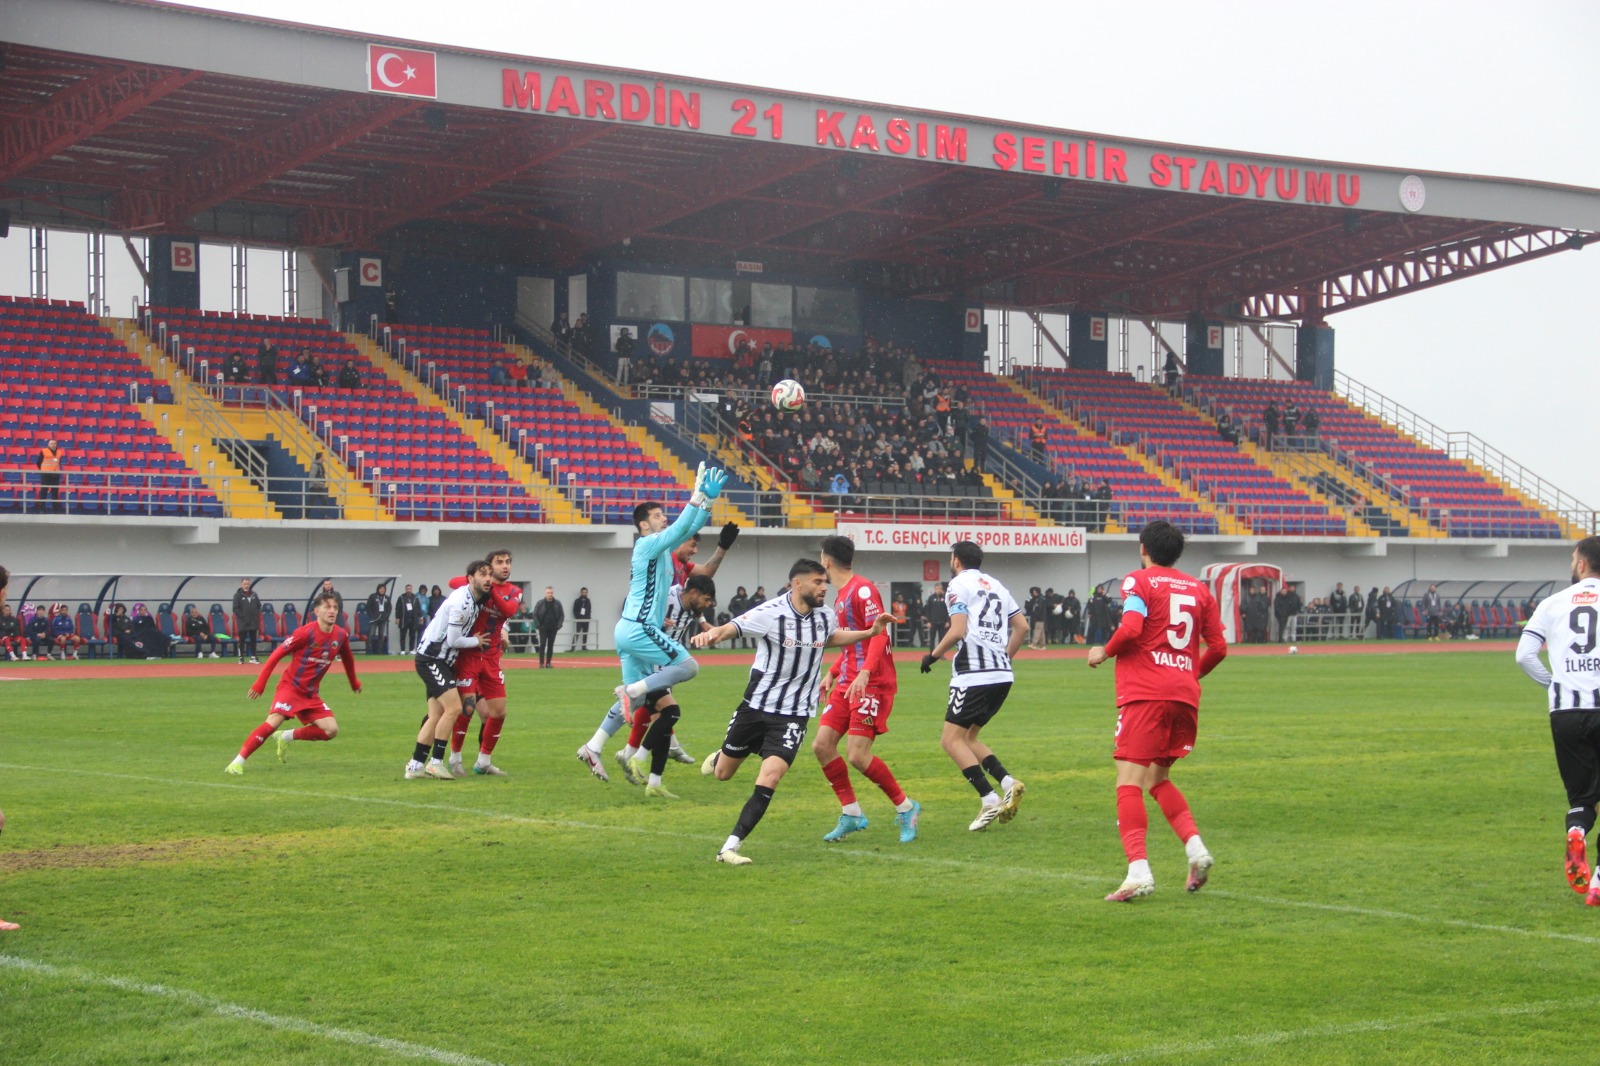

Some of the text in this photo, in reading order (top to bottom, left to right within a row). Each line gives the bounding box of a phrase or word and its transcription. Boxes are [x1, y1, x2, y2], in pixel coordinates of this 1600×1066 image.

[502, 68, 700, 129] MARDİN
[731, 98, 783, 139] 21
[816, 109, 967, 162] KASIM
[992, 132, 1128, 183] ŞEHİR
[1149, 153, 1361, 206] STADYUMU
[174, 247, 193, 267] B
[362, 262, 379, 282] C
[967, 311, 979, 328] D
[1091, 320, 1103, 337] E
[1209, 329, 1219, 345] F
[865, 530, 888, 544] T.C.
[892, 529, 950, 548] GENÇLİK
[976, 532, 1010, 546] SPOR
[1014, 530, 1083, 547] BAKANLIĞI
[977, 590, 1003, 631] 23
[1166, 592, 1196, 650] 5
[1569, 605, 1598, 654] 9
[1151, 651, 1193, 671] YALÇIN
[857, 697, 880, 717] 25
